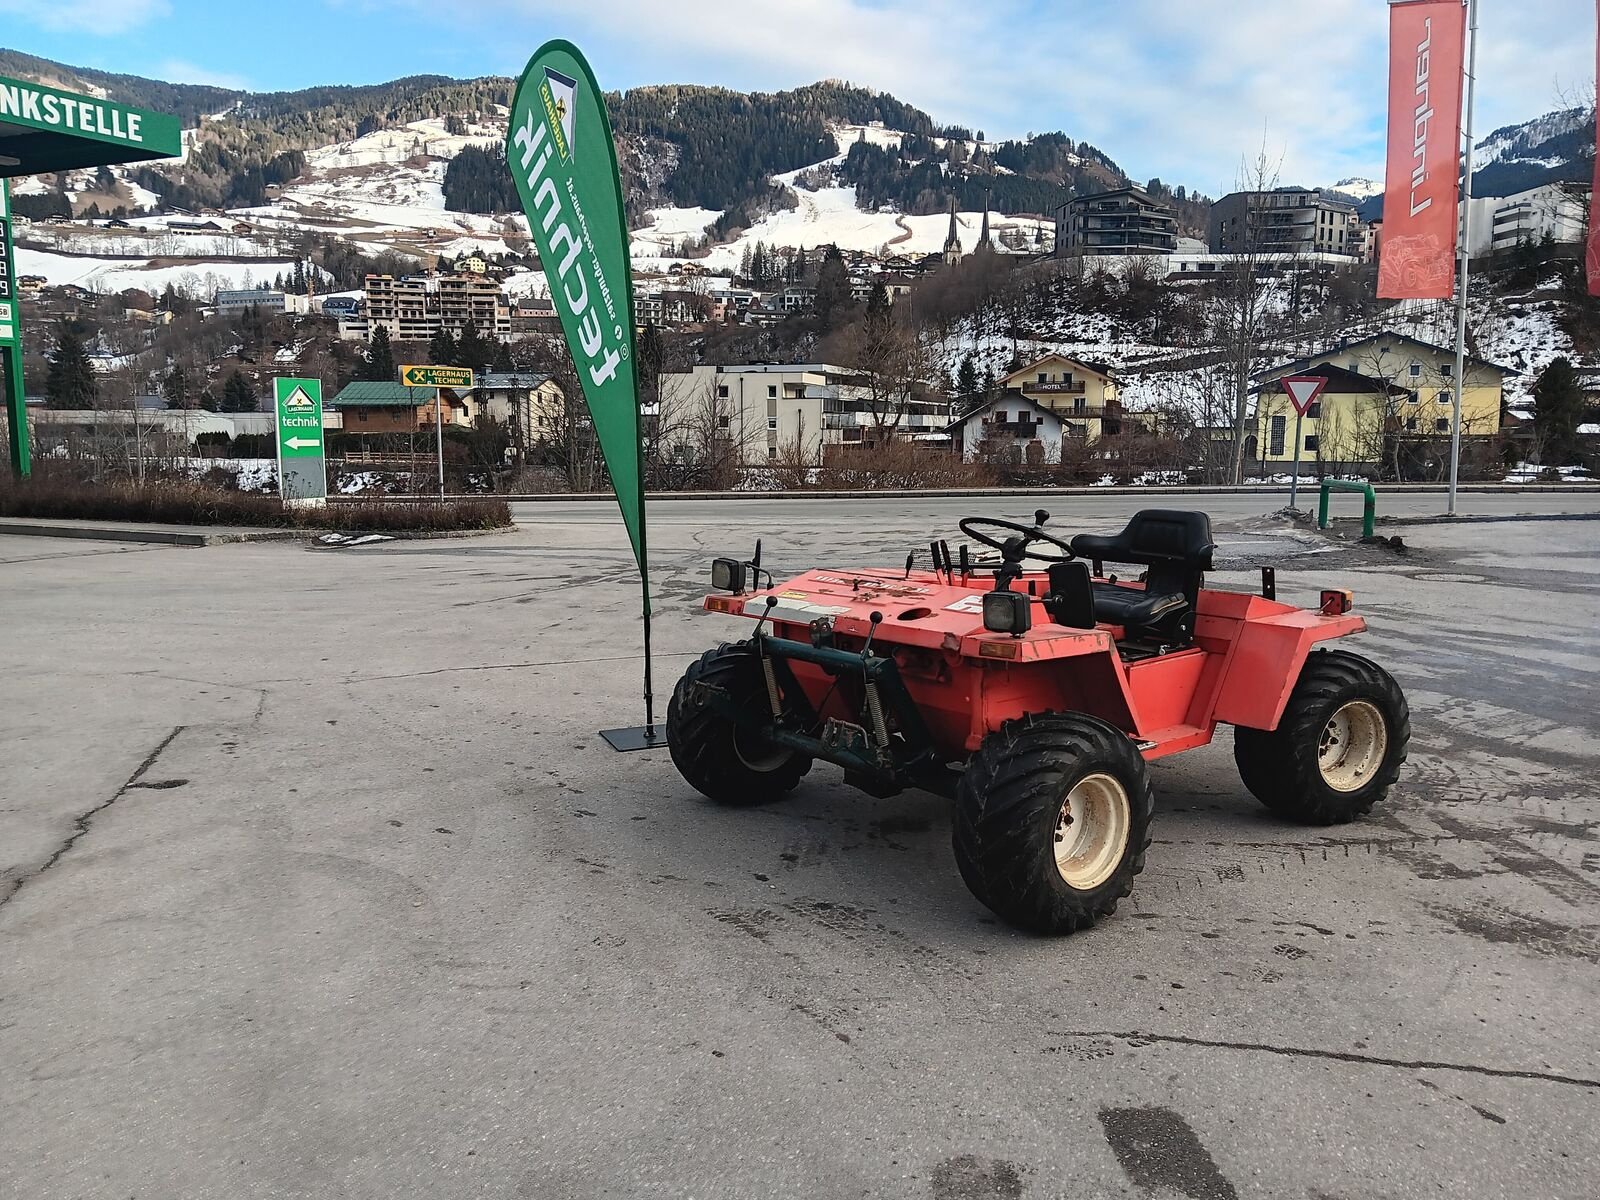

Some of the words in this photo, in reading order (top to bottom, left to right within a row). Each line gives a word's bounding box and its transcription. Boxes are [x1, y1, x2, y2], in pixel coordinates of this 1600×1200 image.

[0, 83, 143, 142] NKSTELLE
[427, 369, 470, 378] LAGERHAUS
[434, 377, 465, 385] TECHNIK
[282, 415, 319, 427] technik
